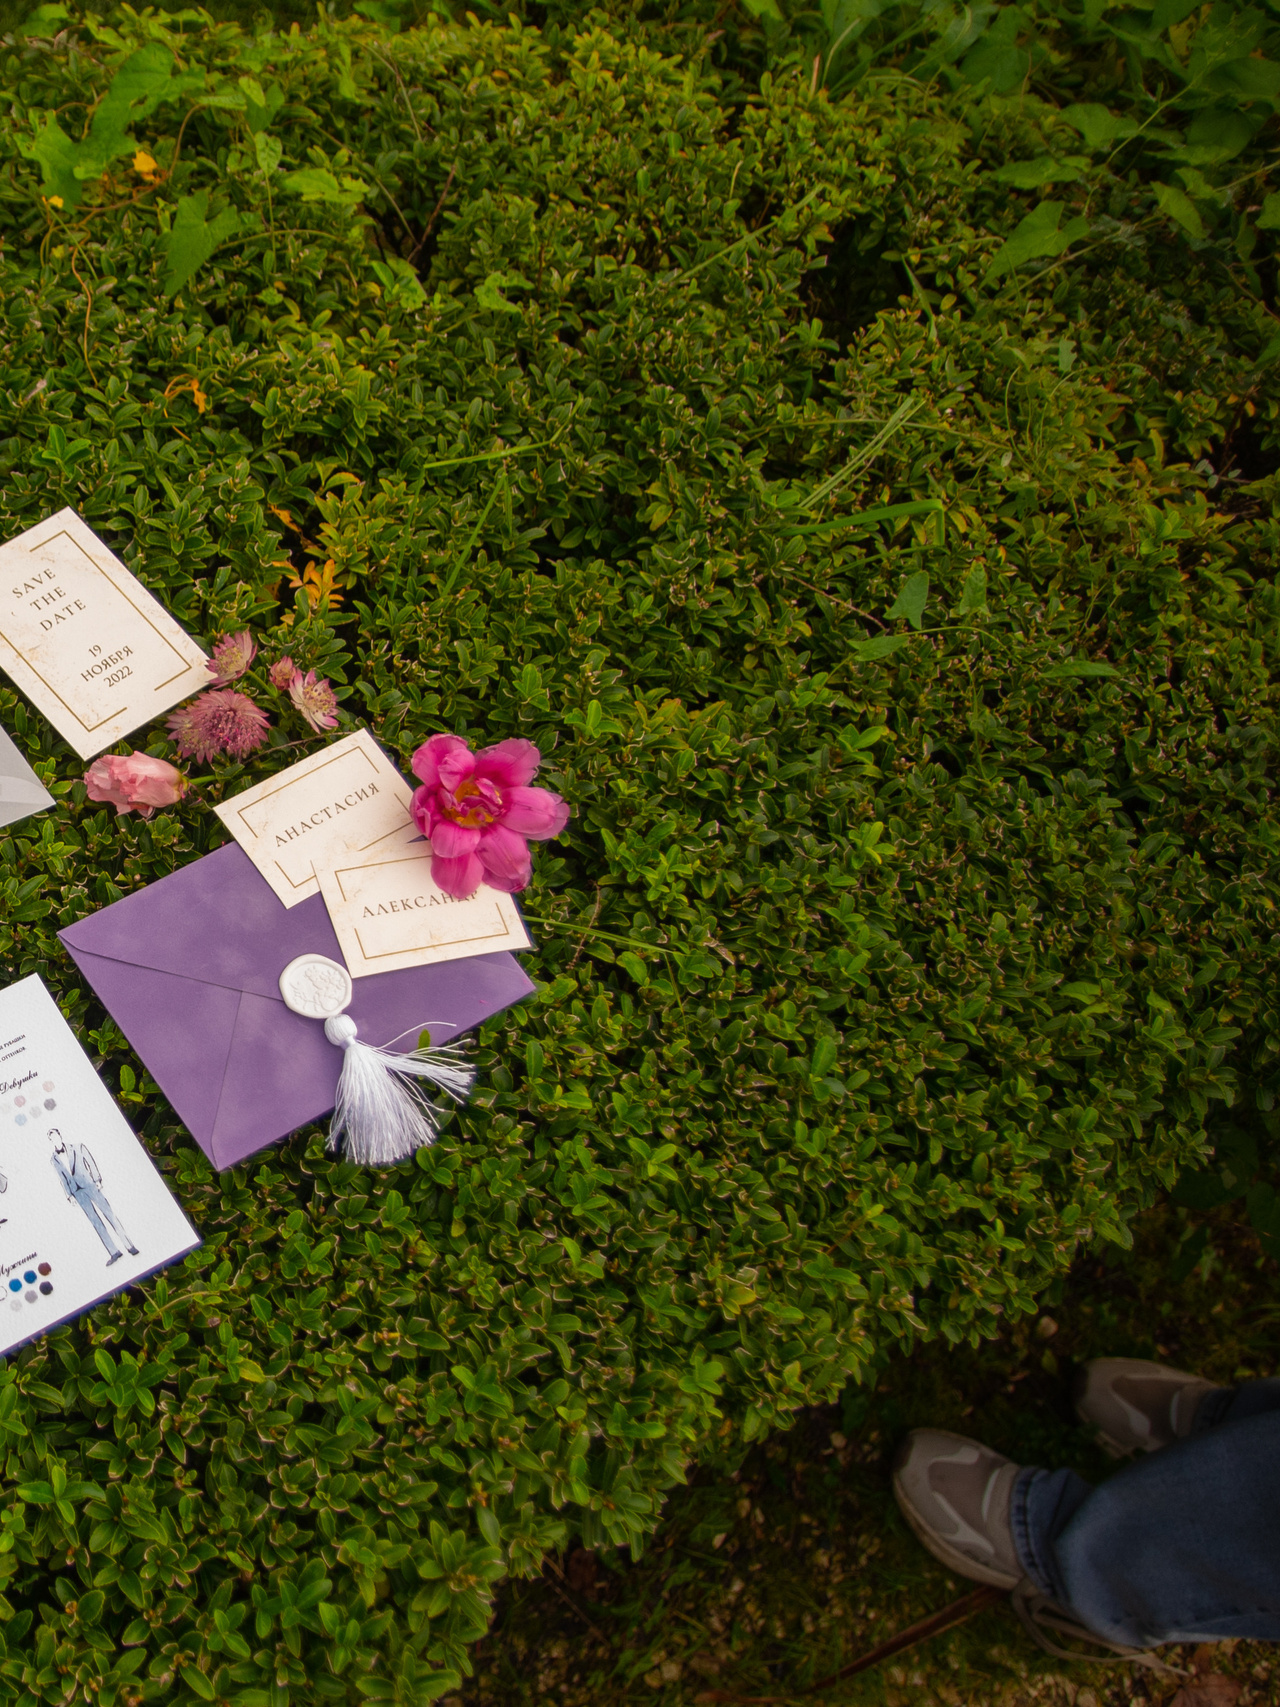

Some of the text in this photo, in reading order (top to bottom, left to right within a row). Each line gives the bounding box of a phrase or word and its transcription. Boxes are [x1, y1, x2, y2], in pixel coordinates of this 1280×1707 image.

[12, 568, 56, 599] SAVE
[29, 586, 66, 611] THE
[39, 599, 86, 631] DATE
[80, 645, 134, 682] НОЯБРЯ
[88, 644, 102, 657] 19
[104, 665, 133, 688] 2022
[274, 782, 380, 848] АНАСТАСИЯ
[363, 890, 478, 918] АЛЕКСАНР
